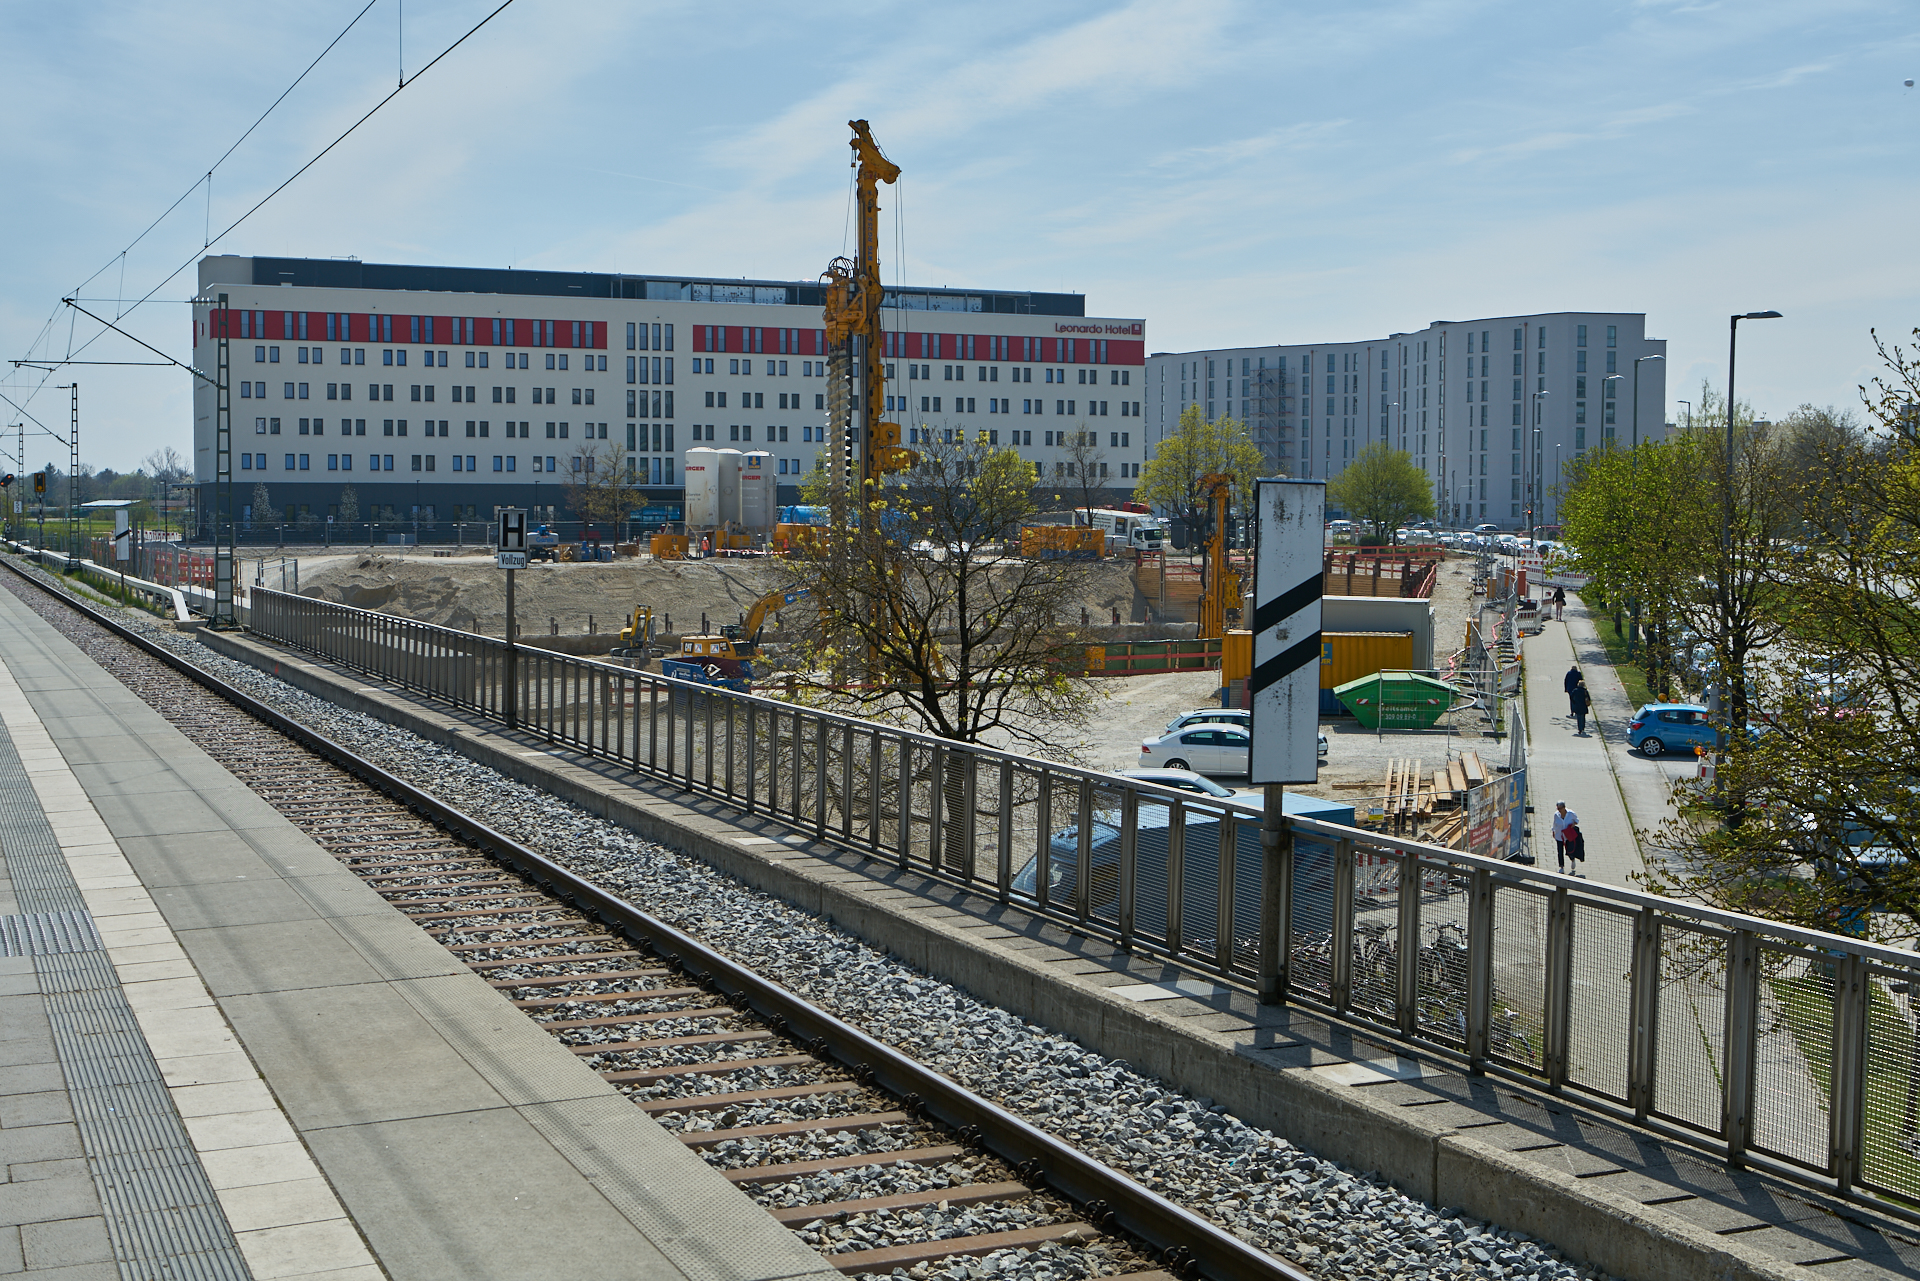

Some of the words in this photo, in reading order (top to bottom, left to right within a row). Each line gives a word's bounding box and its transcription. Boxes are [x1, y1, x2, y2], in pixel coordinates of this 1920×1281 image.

[1055, 322, 1103, 334] Leonardo
[1105, 324, 1131, 335] Hotel
[503, 513, 524, 547] H
[501, 554, 525, 567] Vollzug
